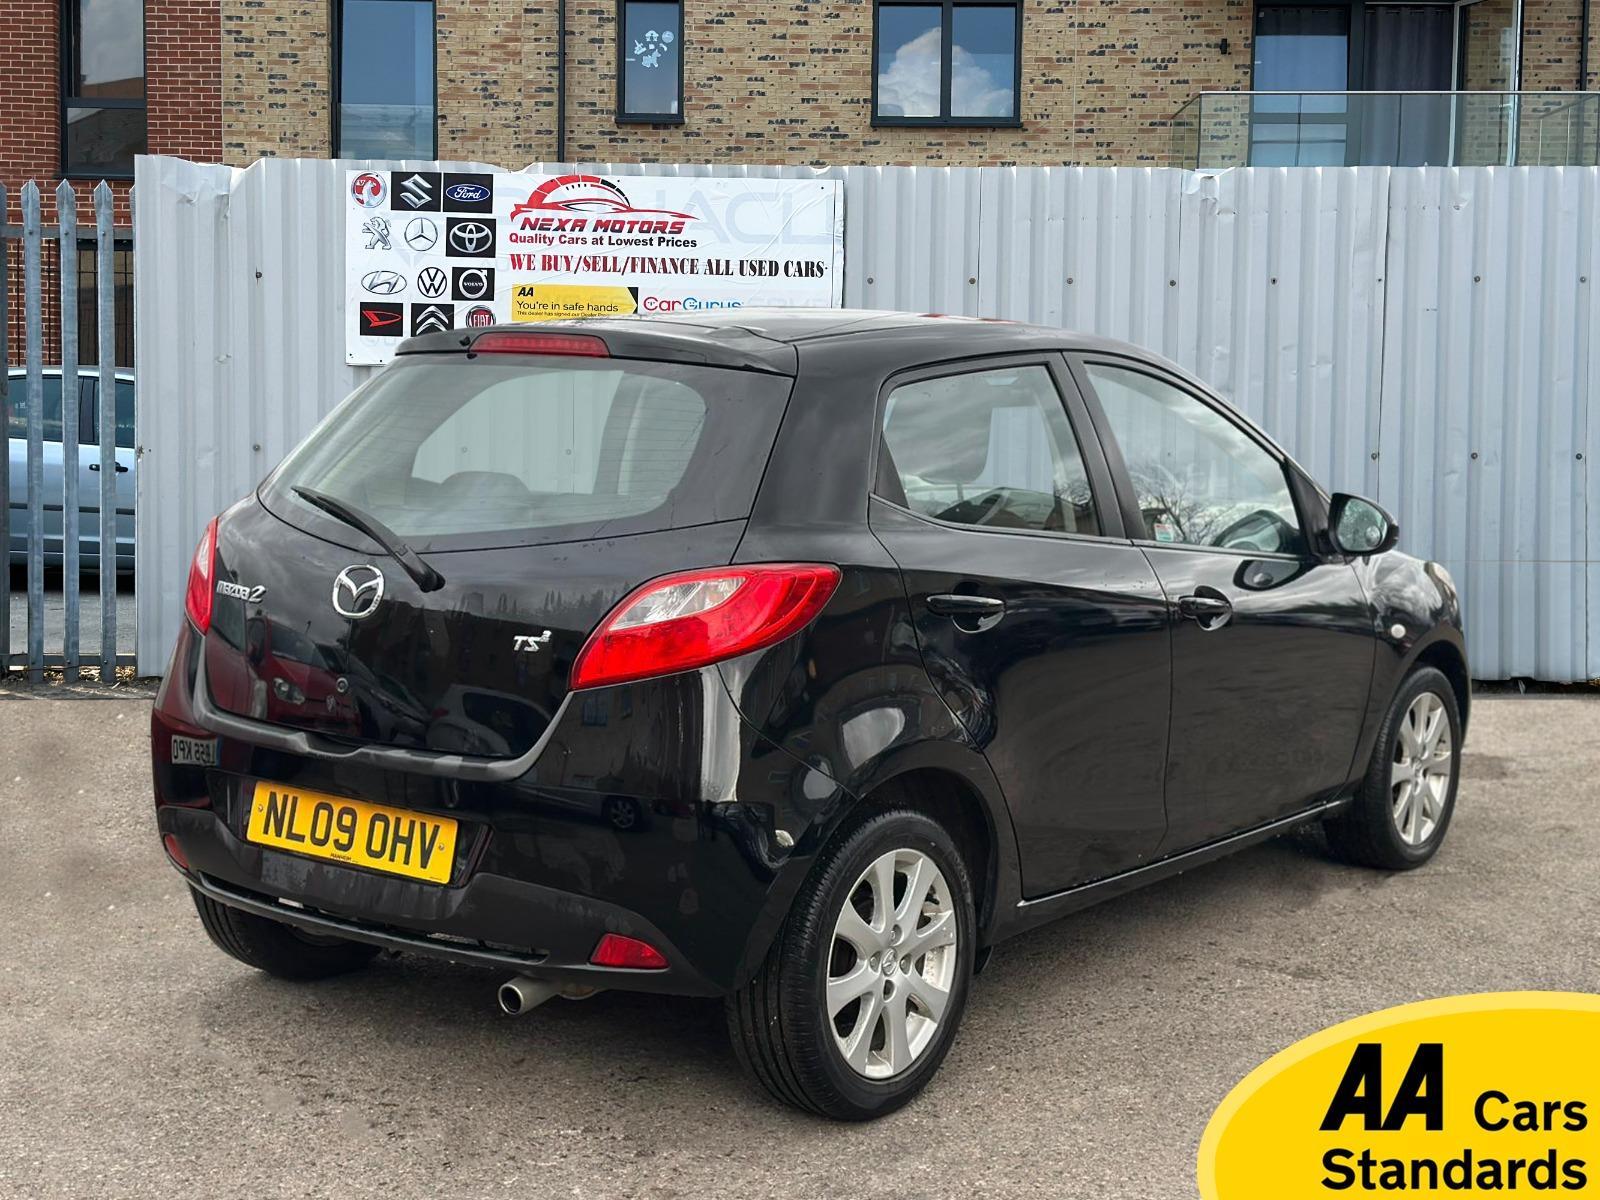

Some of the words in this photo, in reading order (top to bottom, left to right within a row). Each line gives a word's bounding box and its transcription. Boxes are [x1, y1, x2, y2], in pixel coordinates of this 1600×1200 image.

[454, 186, 482, 199] Ford
[520, 217, 587, 232] NEXA
[592, 219, 685, 235] MOTORS
[509, 232, 554, 246] Quality
[558, 234, 588, 245] Cars
[591, 236, 604, 245] at
[608, 236, 653, 246] Lowest
[658, 237, 697, 248] Prices
[509, 253, 536, 271] WE
[541, 254, 699, 276] BUY/SELL/FINANCE
[704, 258, 734, 275] ALL
[739, 260, 779, 277] USED
[518, 287, 534, 296] AA
[517, 300, 549, 310] You're
[551, 301, 560, 310] in
[563, 302, 585, 311] safe
[587, 303, 619, 312] hands
[473, 314, 490, 327] FIAT
[263, 791, 358, 852] NL09
[366, 813, 441, 869] OHV
